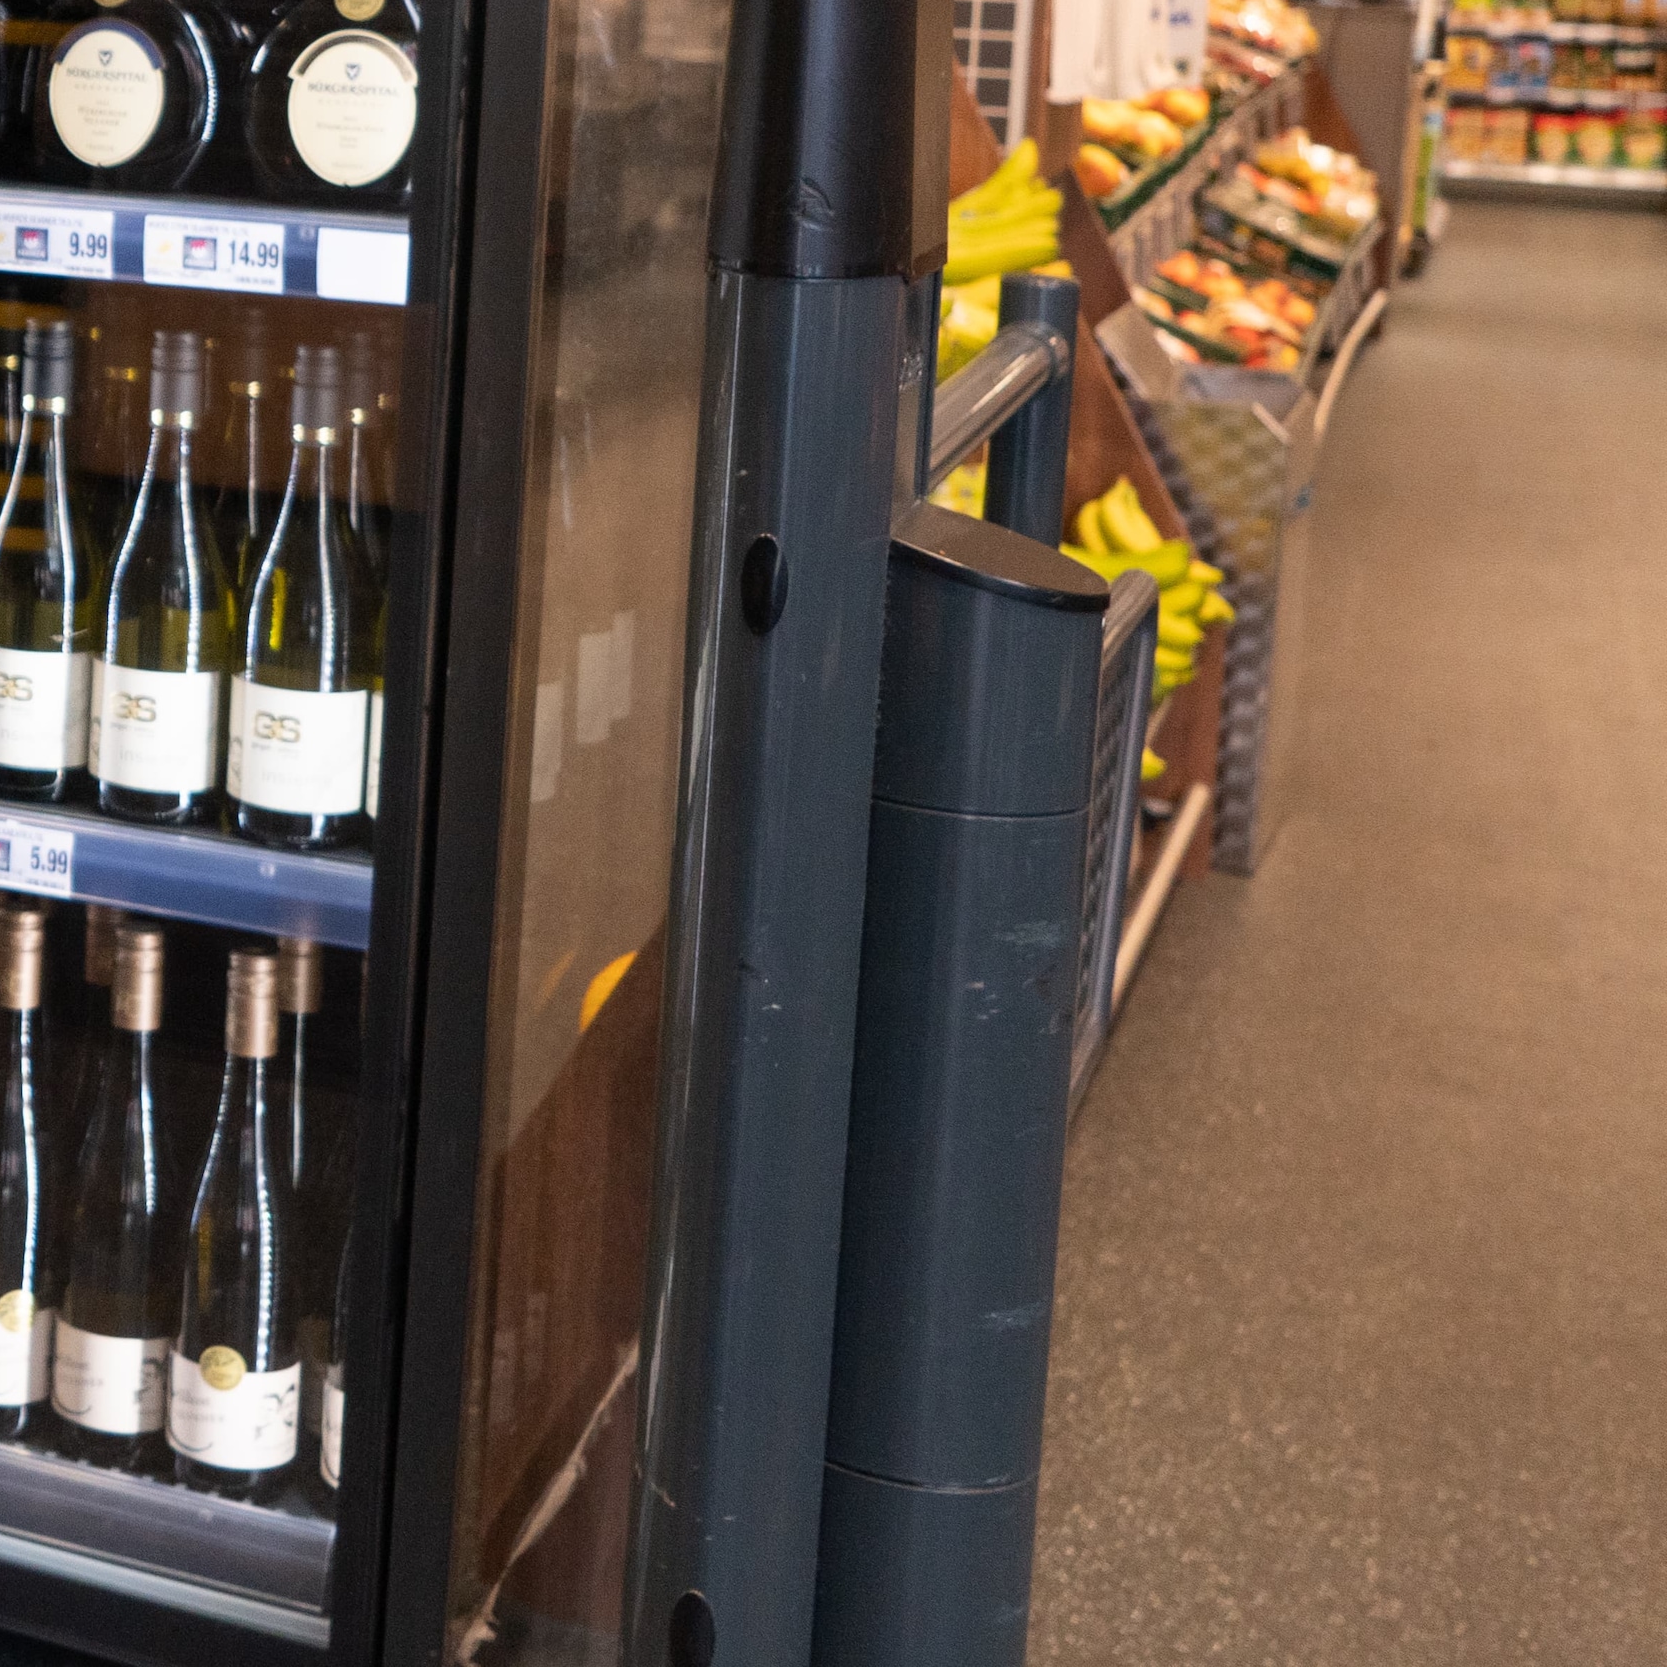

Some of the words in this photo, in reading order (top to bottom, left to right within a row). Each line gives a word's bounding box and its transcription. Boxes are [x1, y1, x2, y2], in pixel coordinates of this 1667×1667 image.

[69, 231, 108, 259] 9.99
[228, 239, 279, 269] 14.99
[30, 845, 68, 875] 5.99
